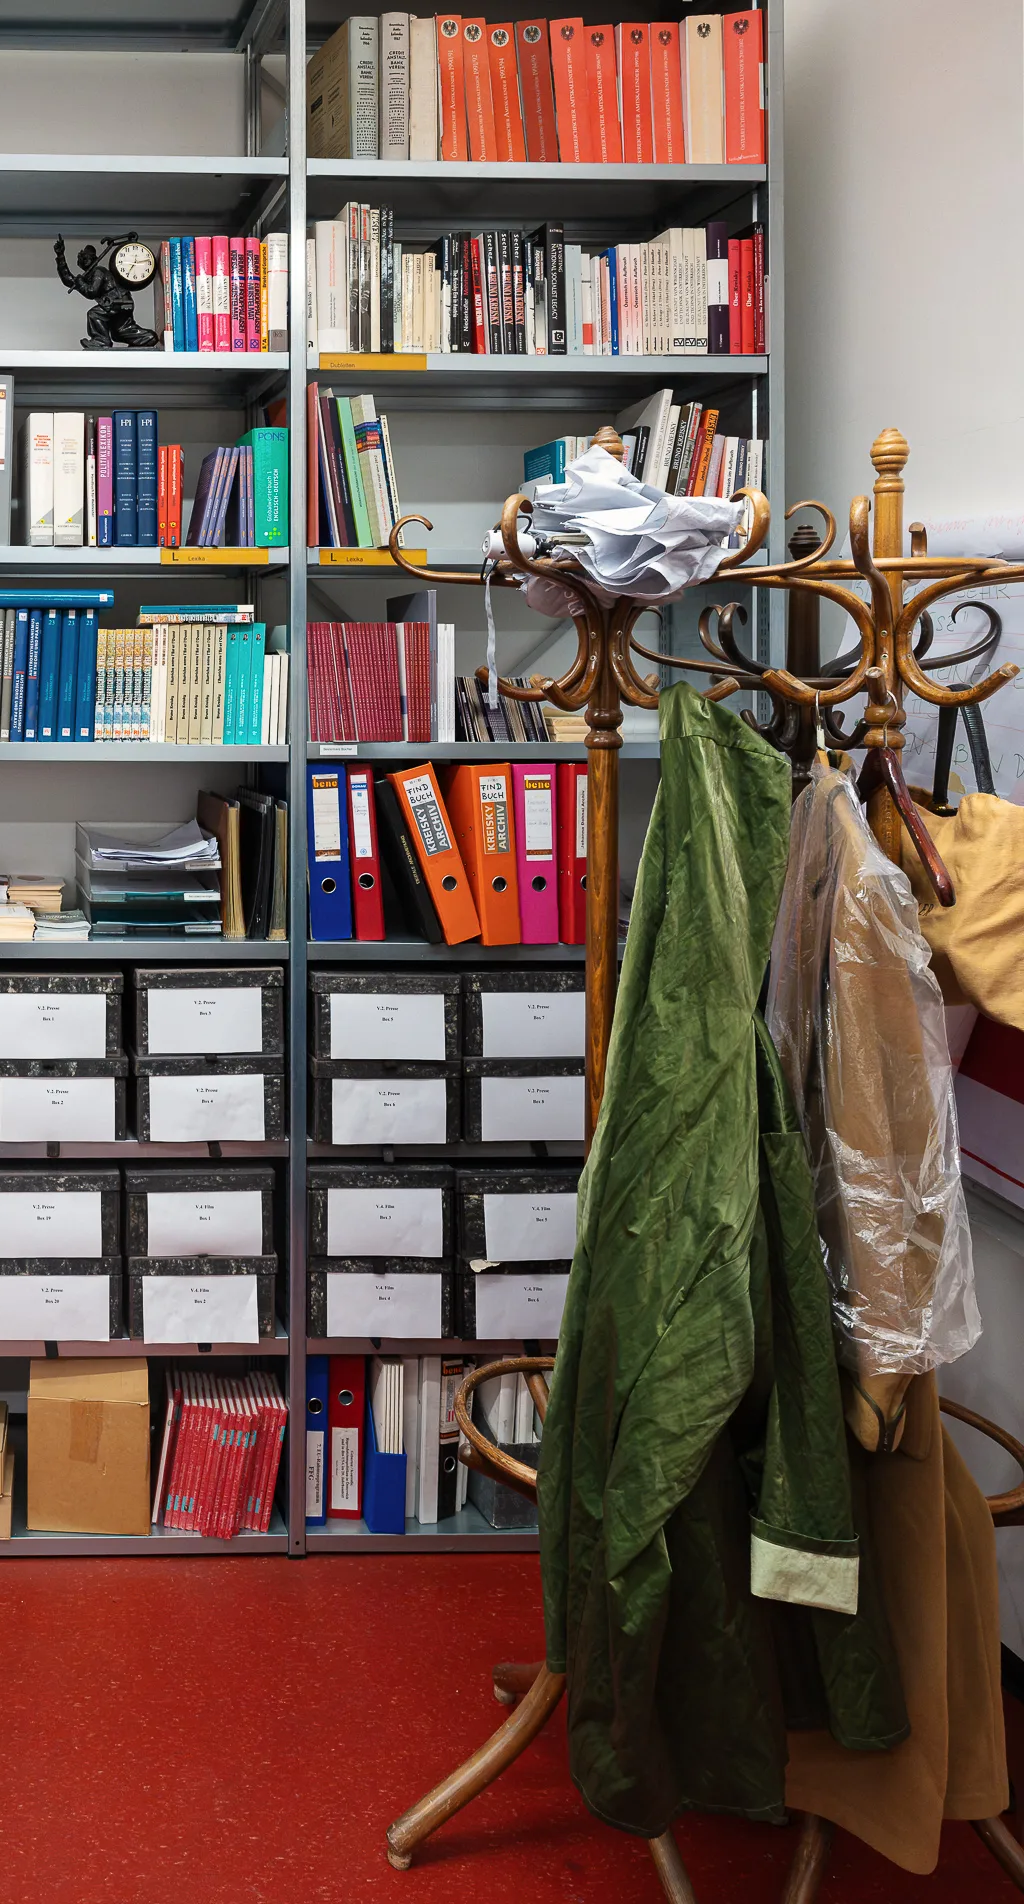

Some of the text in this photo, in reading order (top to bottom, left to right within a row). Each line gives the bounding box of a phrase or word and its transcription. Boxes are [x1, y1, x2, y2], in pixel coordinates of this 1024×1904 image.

[486, 234, 494, 260] Secher
[490, 296, 500, 326] KREISKY
[504, 296, 513, 325] KREISKY
[516, 296, 524, 326] KREISKY
[258, 432, 285, 442] PONS
[705, 413, 717, 445] KREISKY
[664, 422, 676, 467] BRUNO KREISKY
[673, 420, 687, 470] BRUNO KREISKY
[725, 477, 733, 498] sterreich
[172, 552, 179, 562] L
[331, 553, 337, 562] L
[313, 777, 338, 788] bene
[406, 783, 429, 795] FIND
[480, 782, 502, 793] FIND
[525, 779, 550, 790] bene
[410, 791, 433, 804] BUCH
[481, 792, 504, 800] BUCH
[415, 808, 437, 854] KREISKY
[427, 803, 449, 848] ARCHIV
[485, 804, 495, 851] KREISKY
[496, 804, 508, 850] ARCHIV
